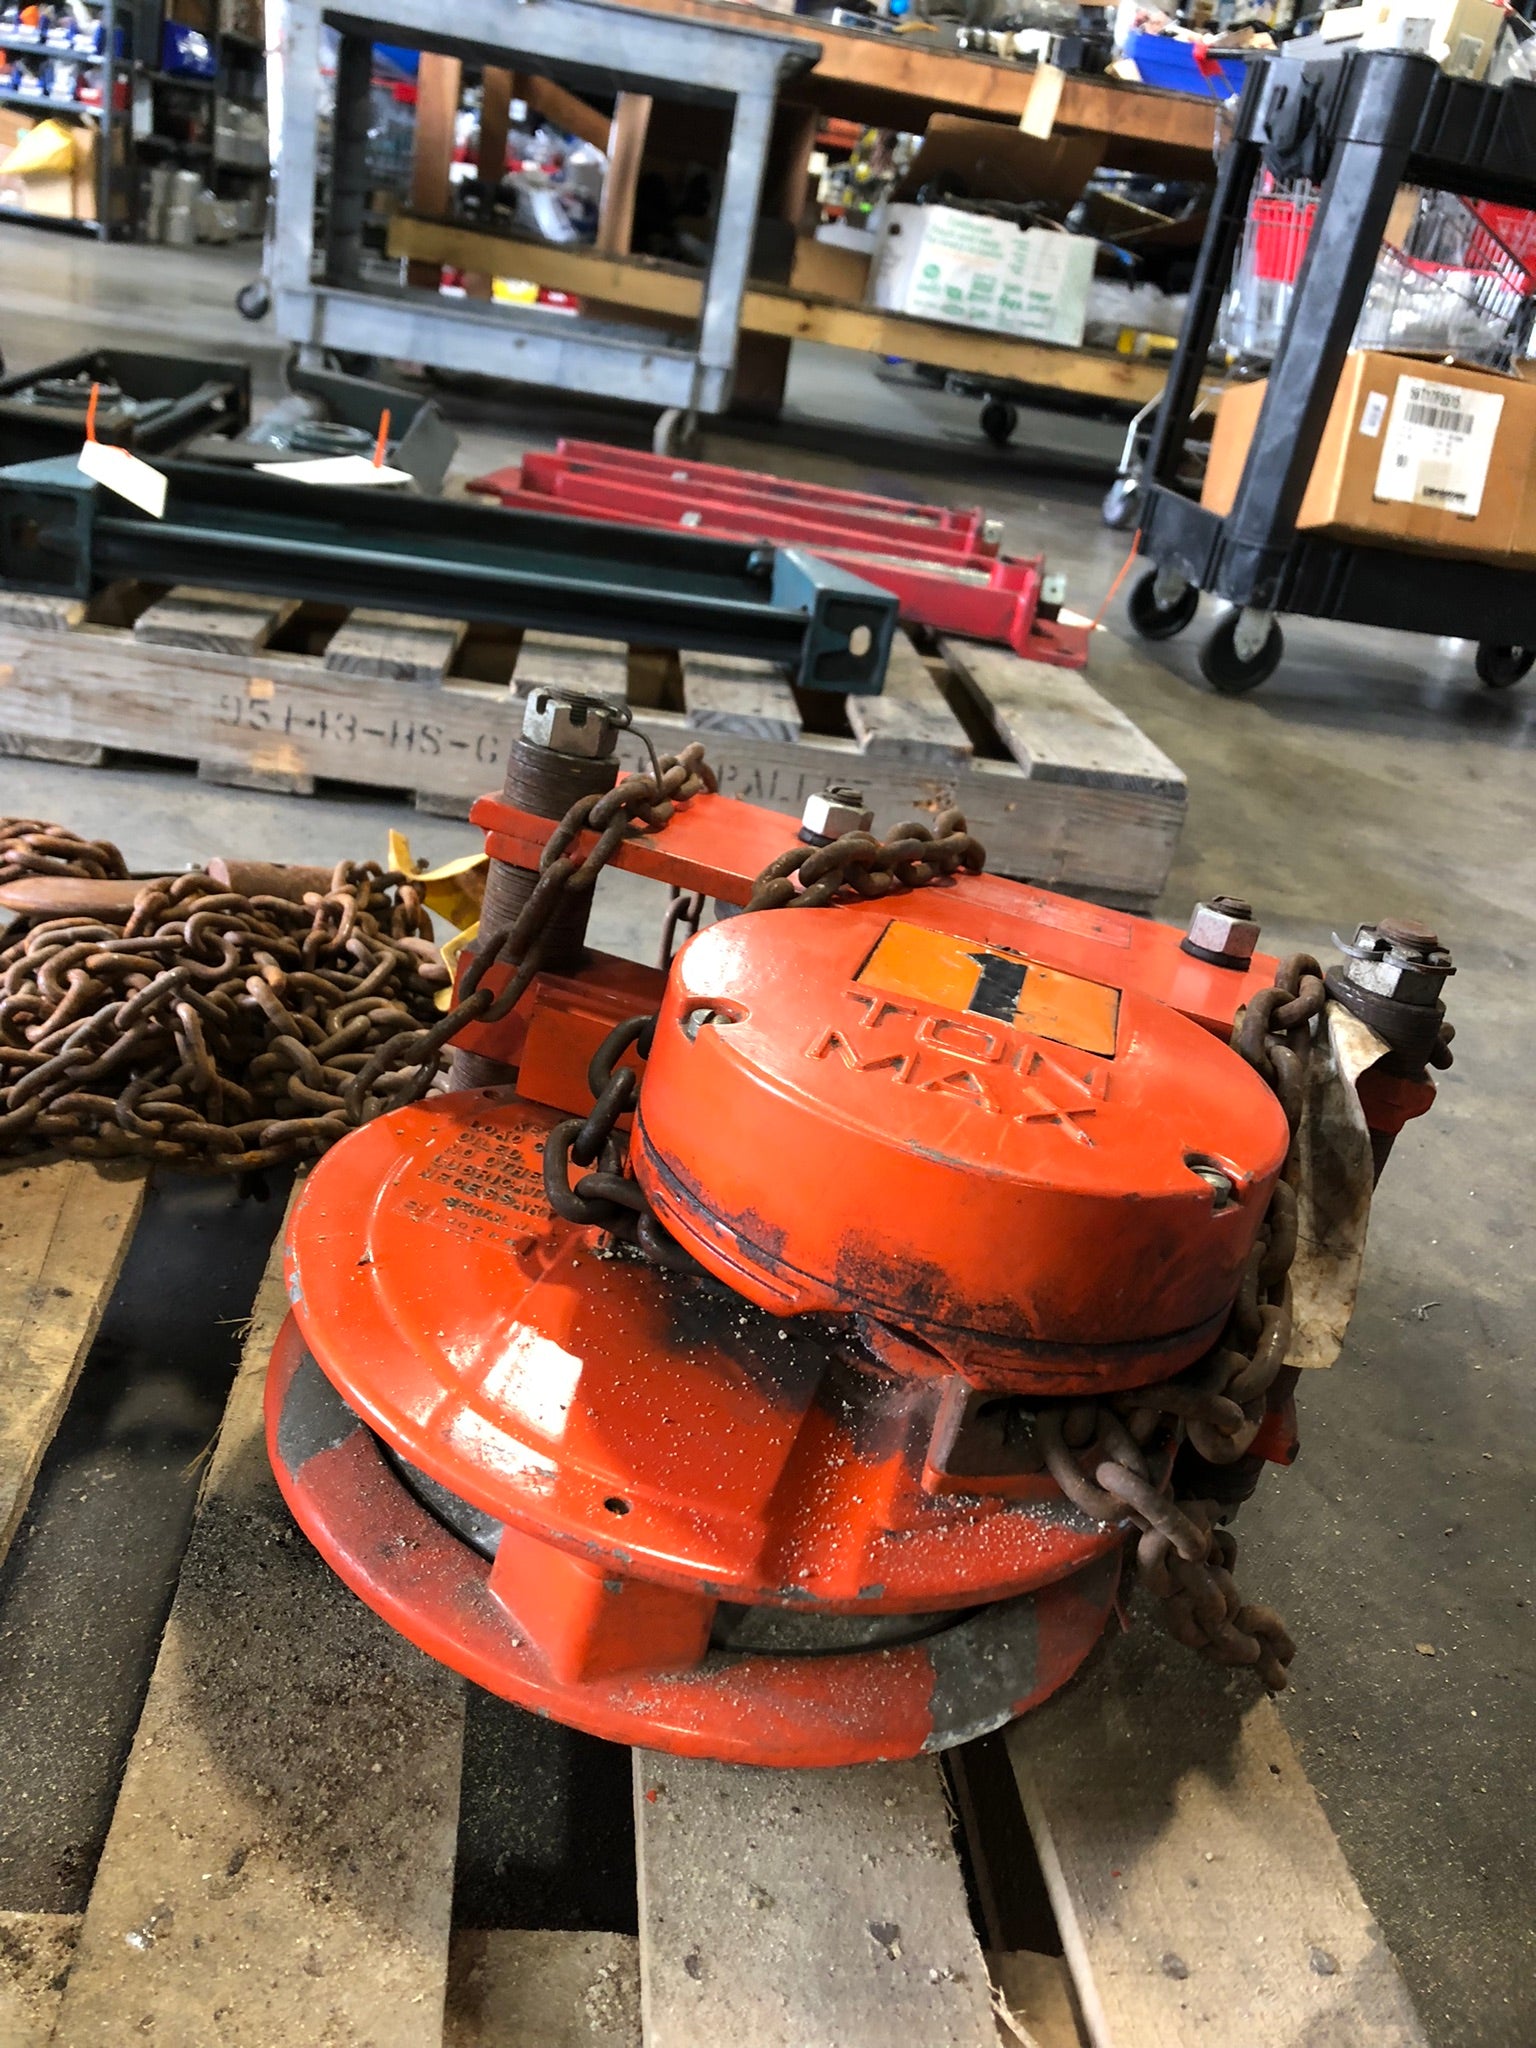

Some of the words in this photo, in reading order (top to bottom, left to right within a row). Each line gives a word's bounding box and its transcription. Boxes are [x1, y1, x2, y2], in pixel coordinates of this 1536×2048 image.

[964, 951, 1029, 1026] 1
[804, 1026, 1097, 1149] MAX
[841, 990, 1110, 1101] TON
[485, 1156, 544, 1184] OTHE
